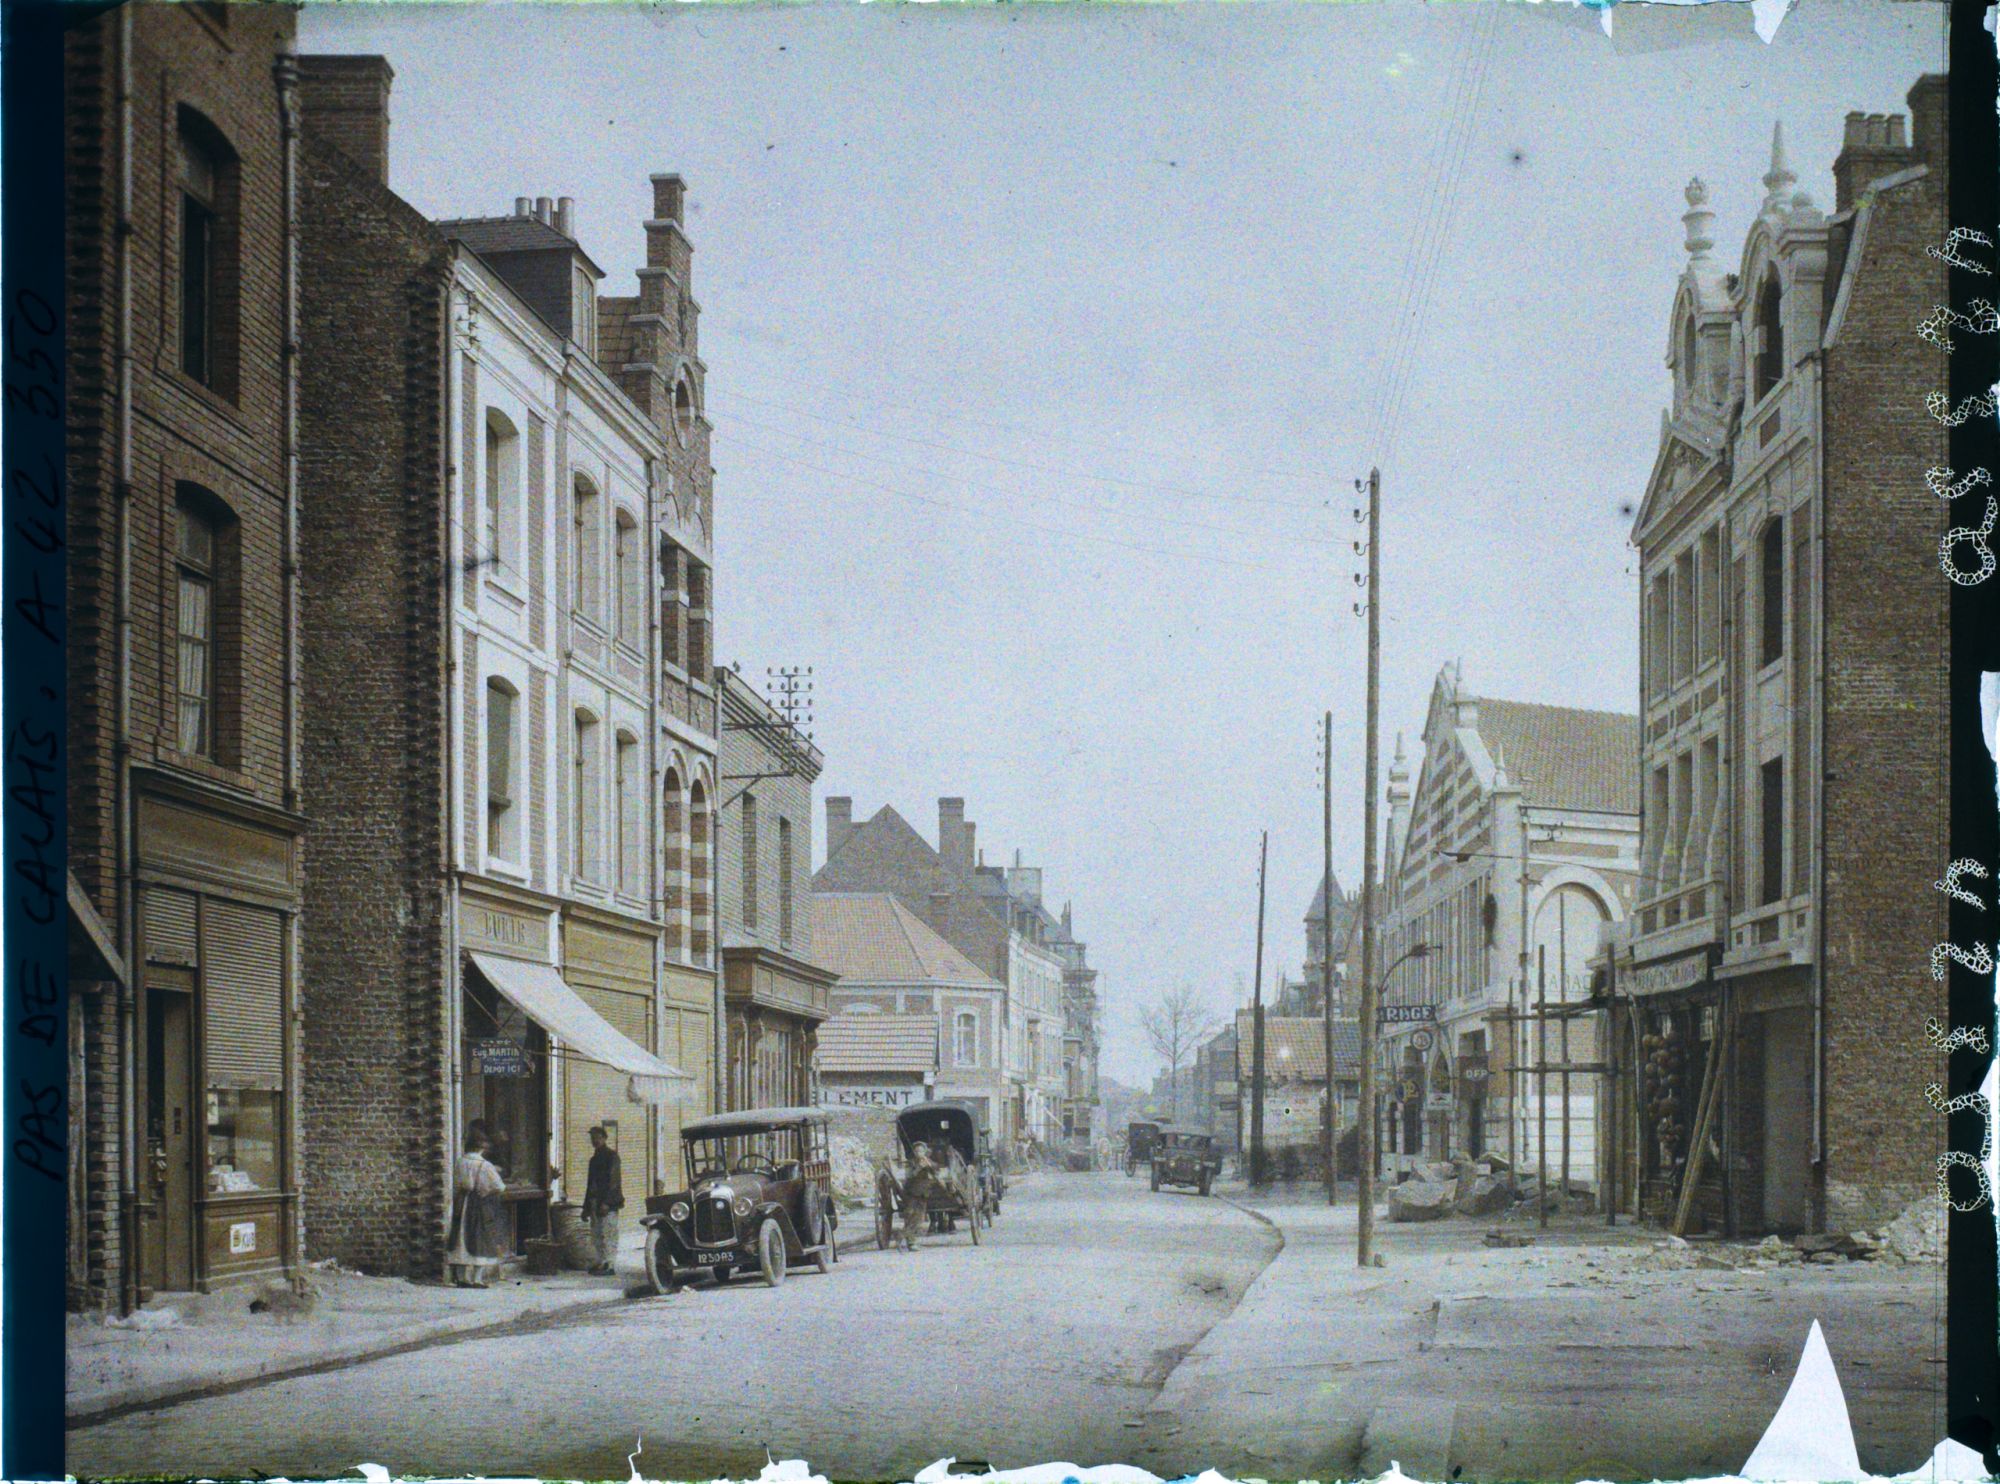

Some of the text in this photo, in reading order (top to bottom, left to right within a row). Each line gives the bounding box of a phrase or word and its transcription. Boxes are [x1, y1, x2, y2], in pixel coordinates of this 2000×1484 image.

[5, 288, 60, 421] 350
[14, 568, 60, 647] A
[17, 959, 60, 1048] DE
[488, 1047, 520, 1057] MARTIN
[13, 1079, 63, 1182] PAS
